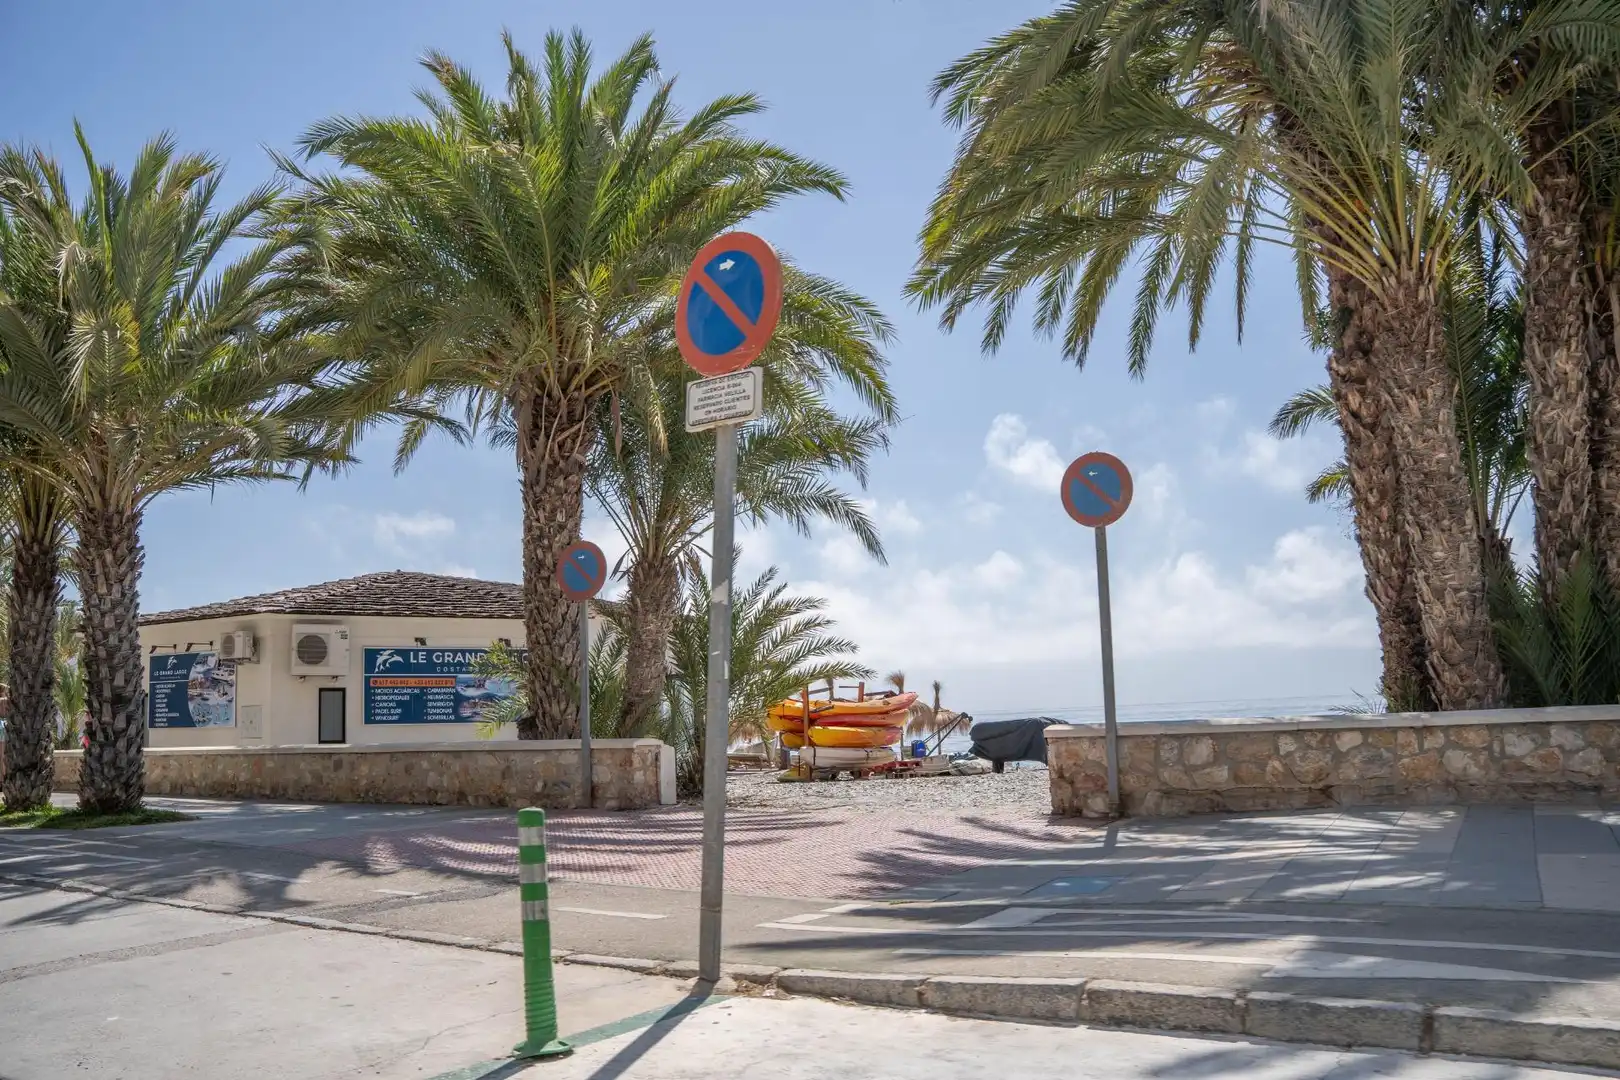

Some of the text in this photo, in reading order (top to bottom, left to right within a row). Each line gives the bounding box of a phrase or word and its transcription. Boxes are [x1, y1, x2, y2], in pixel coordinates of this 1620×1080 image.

[697, 393, 723, 402] FARMACIA
[693, 395, 751, 411] RESERVADO CLIENTES
[713, 405, 737, 413] HORARIO
[410, 651, 427, 663] LE
[432, 651, 487, 663] GRAND
